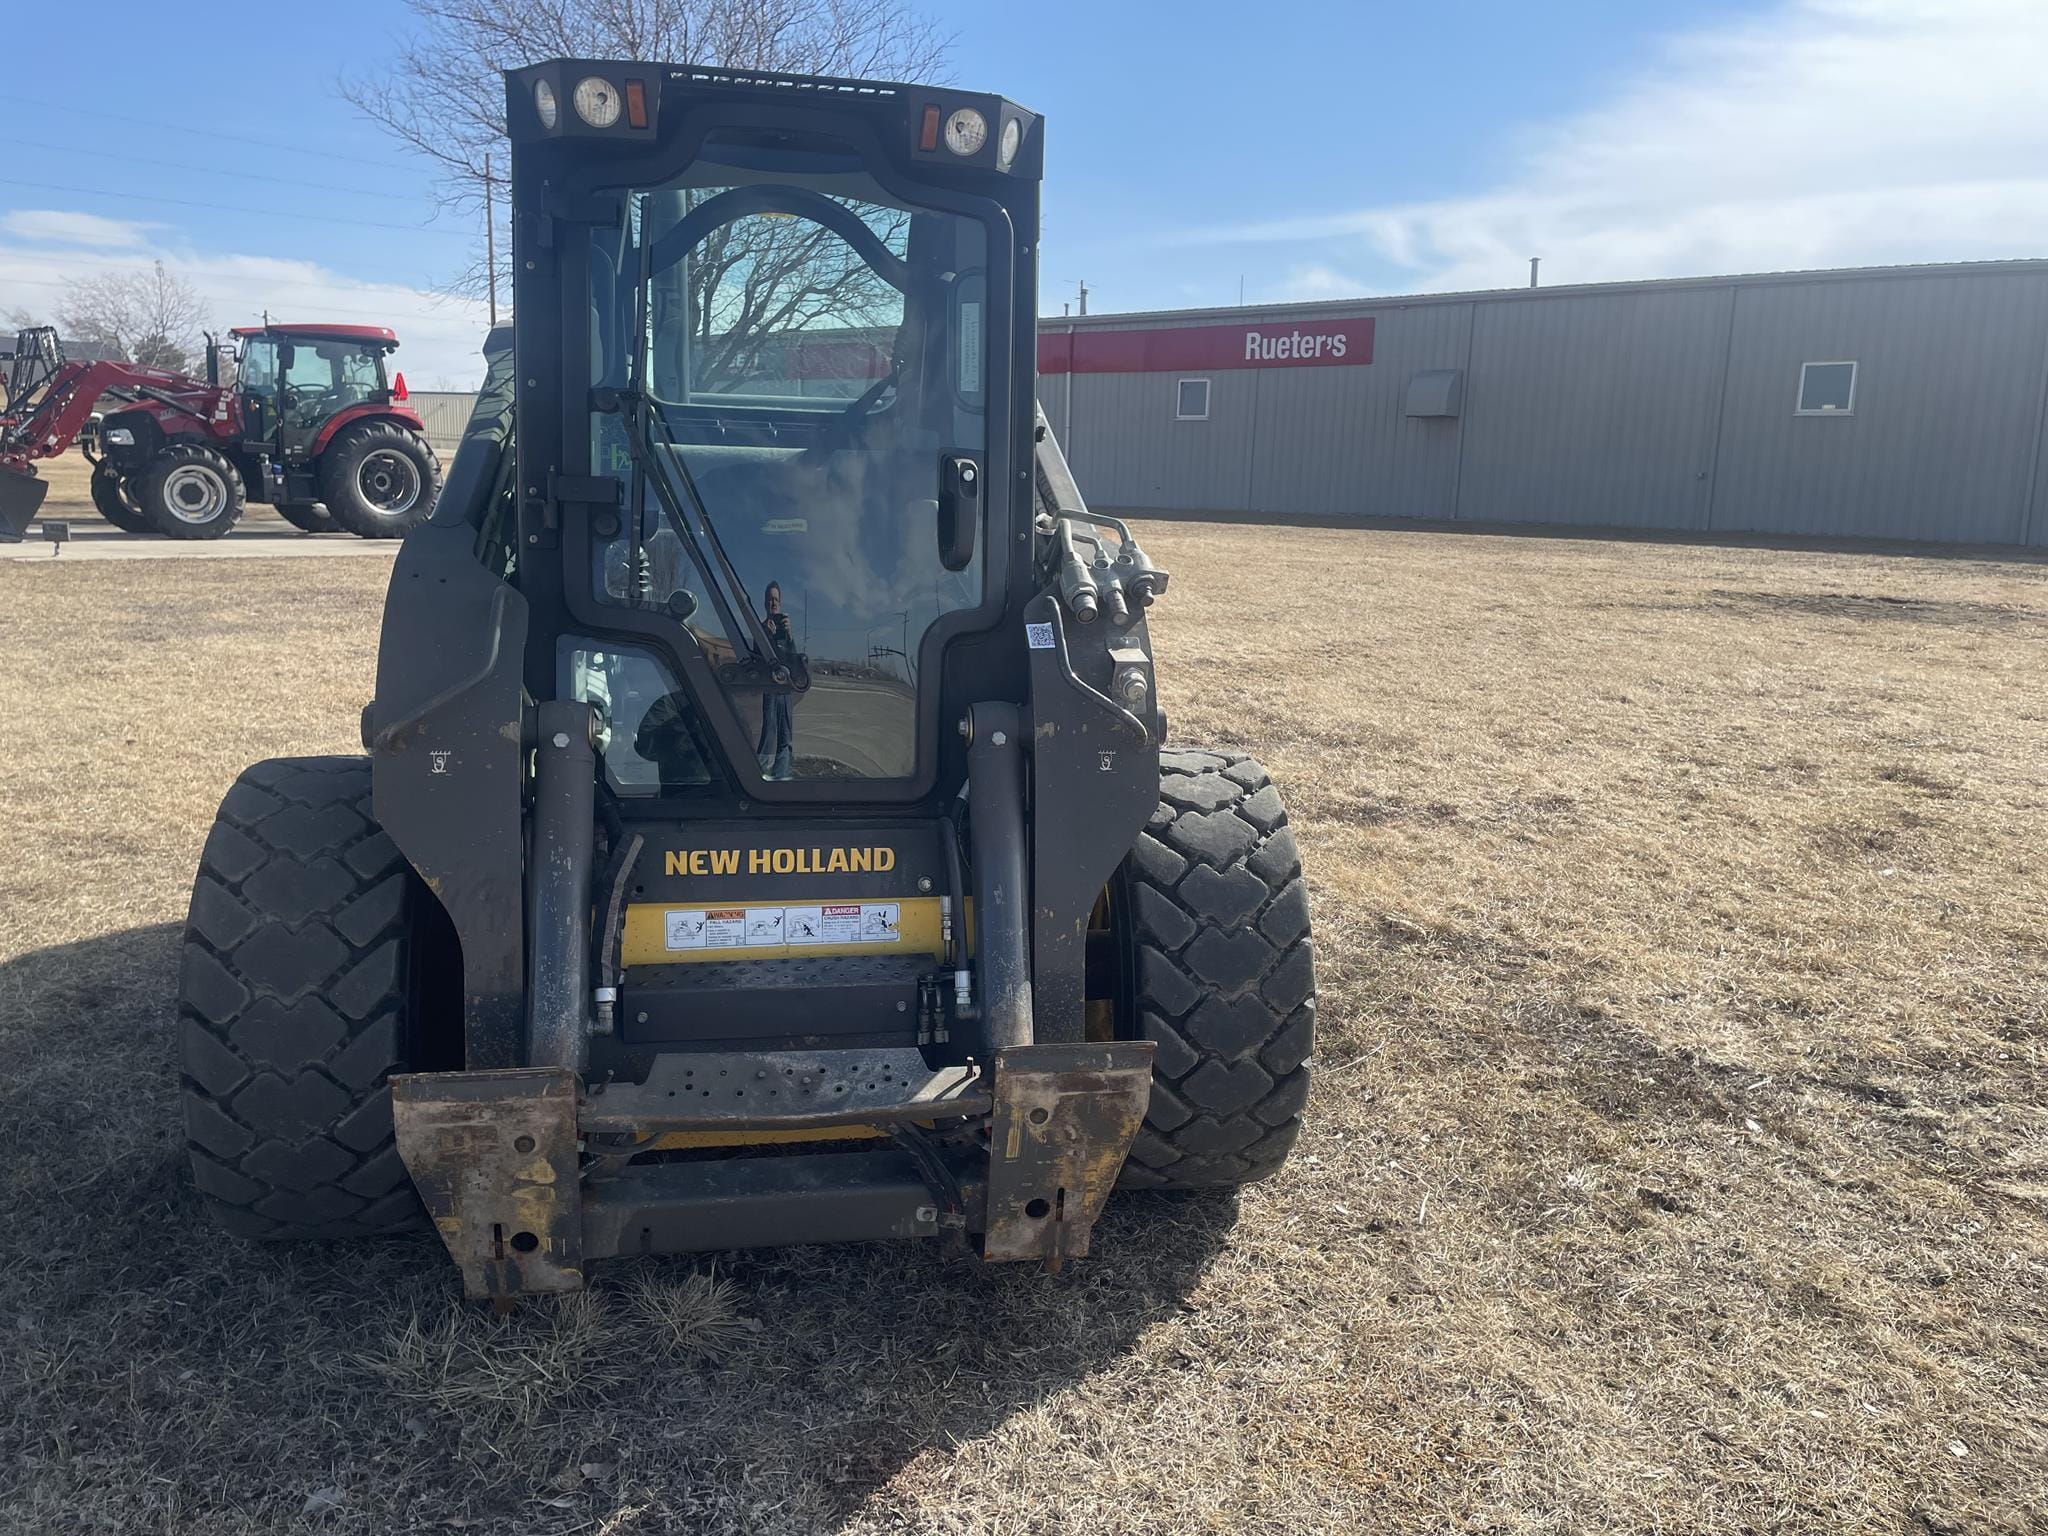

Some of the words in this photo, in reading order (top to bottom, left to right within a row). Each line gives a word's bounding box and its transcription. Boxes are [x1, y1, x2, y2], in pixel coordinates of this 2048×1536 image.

[1245, 331, 1347, 360] Rueter's
[665, 850, 740, 876] NEW
[749, 847, 895, 874] HOLLAND
[713, 911, 744, 919] WARNING
[832, 907, 859, 915] DANGER
